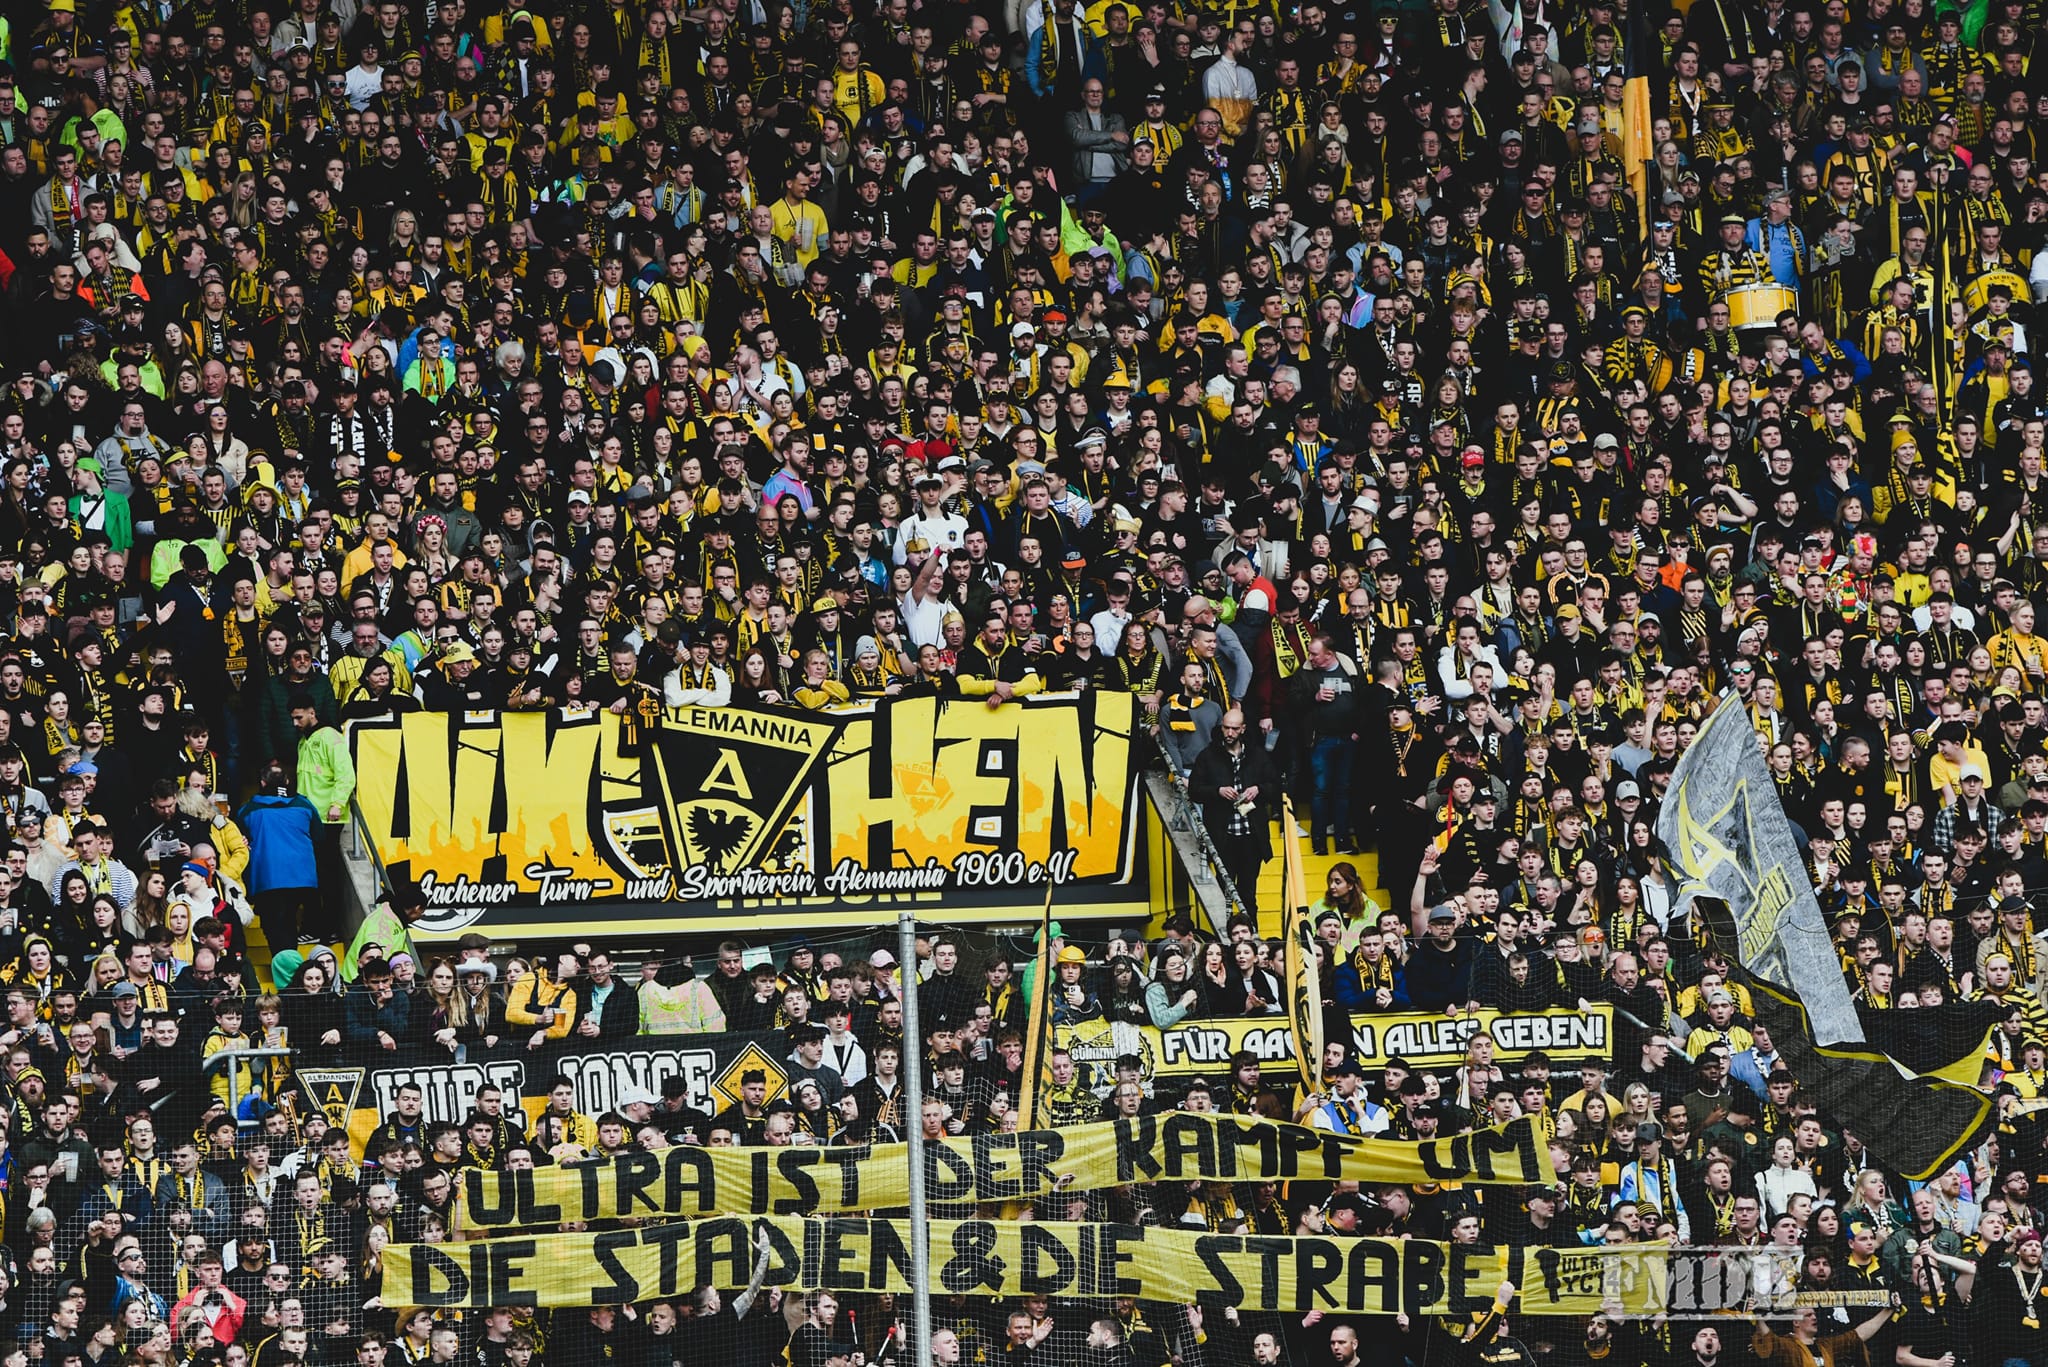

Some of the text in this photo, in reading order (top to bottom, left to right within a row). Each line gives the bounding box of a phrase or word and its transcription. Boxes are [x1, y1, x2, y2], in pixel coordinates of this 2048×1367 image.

[660, 706, 812, 748] ALEMANNIA
[525, 865, 610, 905] Turn-
[626, 870, 671, 899] und
[679, 865, 816, 899] Sportverein
[824, 859, 946, 890] Alemannia
[954, 852, 1024, 886] 1900
[1164, 1027, 1231, 1061] FÜR
[1386, 1020, 1480, 1054] ALLES
[1492, 1016, 1603, 1048] GEBEN!
[307, 1073, 357, 1082] ALEMANNIA
[468, 1112, 1540, 1225] ULTRA IST DER KAMPF UM
[410, 1240, 537, 1307] DIE
[593, 1217, 928, 1304] STADIEN
[1021, 1223, 1145, 1297] DIE
